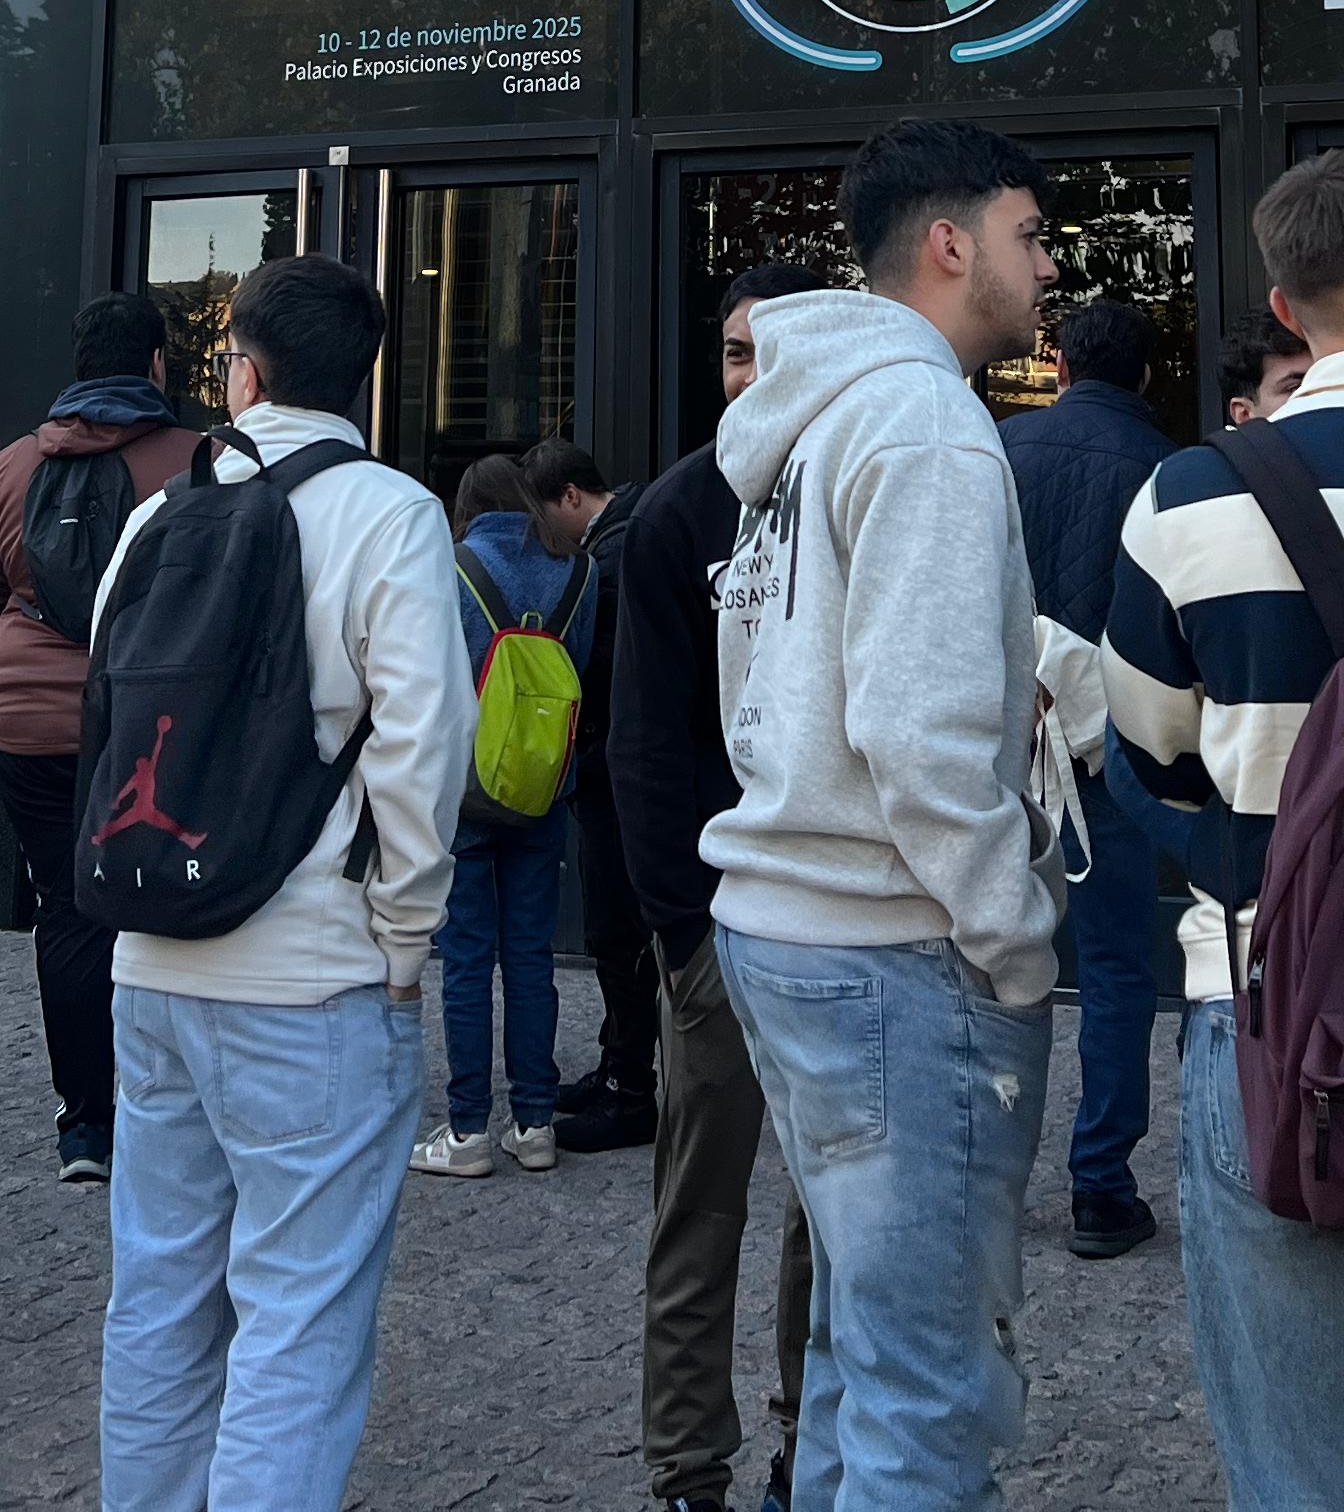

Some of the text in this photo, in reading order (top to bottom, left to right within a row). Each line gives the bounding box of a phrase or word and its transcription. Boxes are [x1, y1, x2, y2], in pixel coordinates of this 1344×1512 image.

[317, 32, 341, 54] 10
[358, 29, 381, 50] 12
[386, 26, 412, 49] de
[417, 20, 527, 46] noviembre
[531, 16, 582, 40] 2025
[284, 47, 582, 81] Palacio Exposiciones y Congresos
[502, 71, 581, 94] Granada
[764, 553, 774, 571] Y
[720, 589, 746, 610] OS
[738, 705, 762, 727] DON
